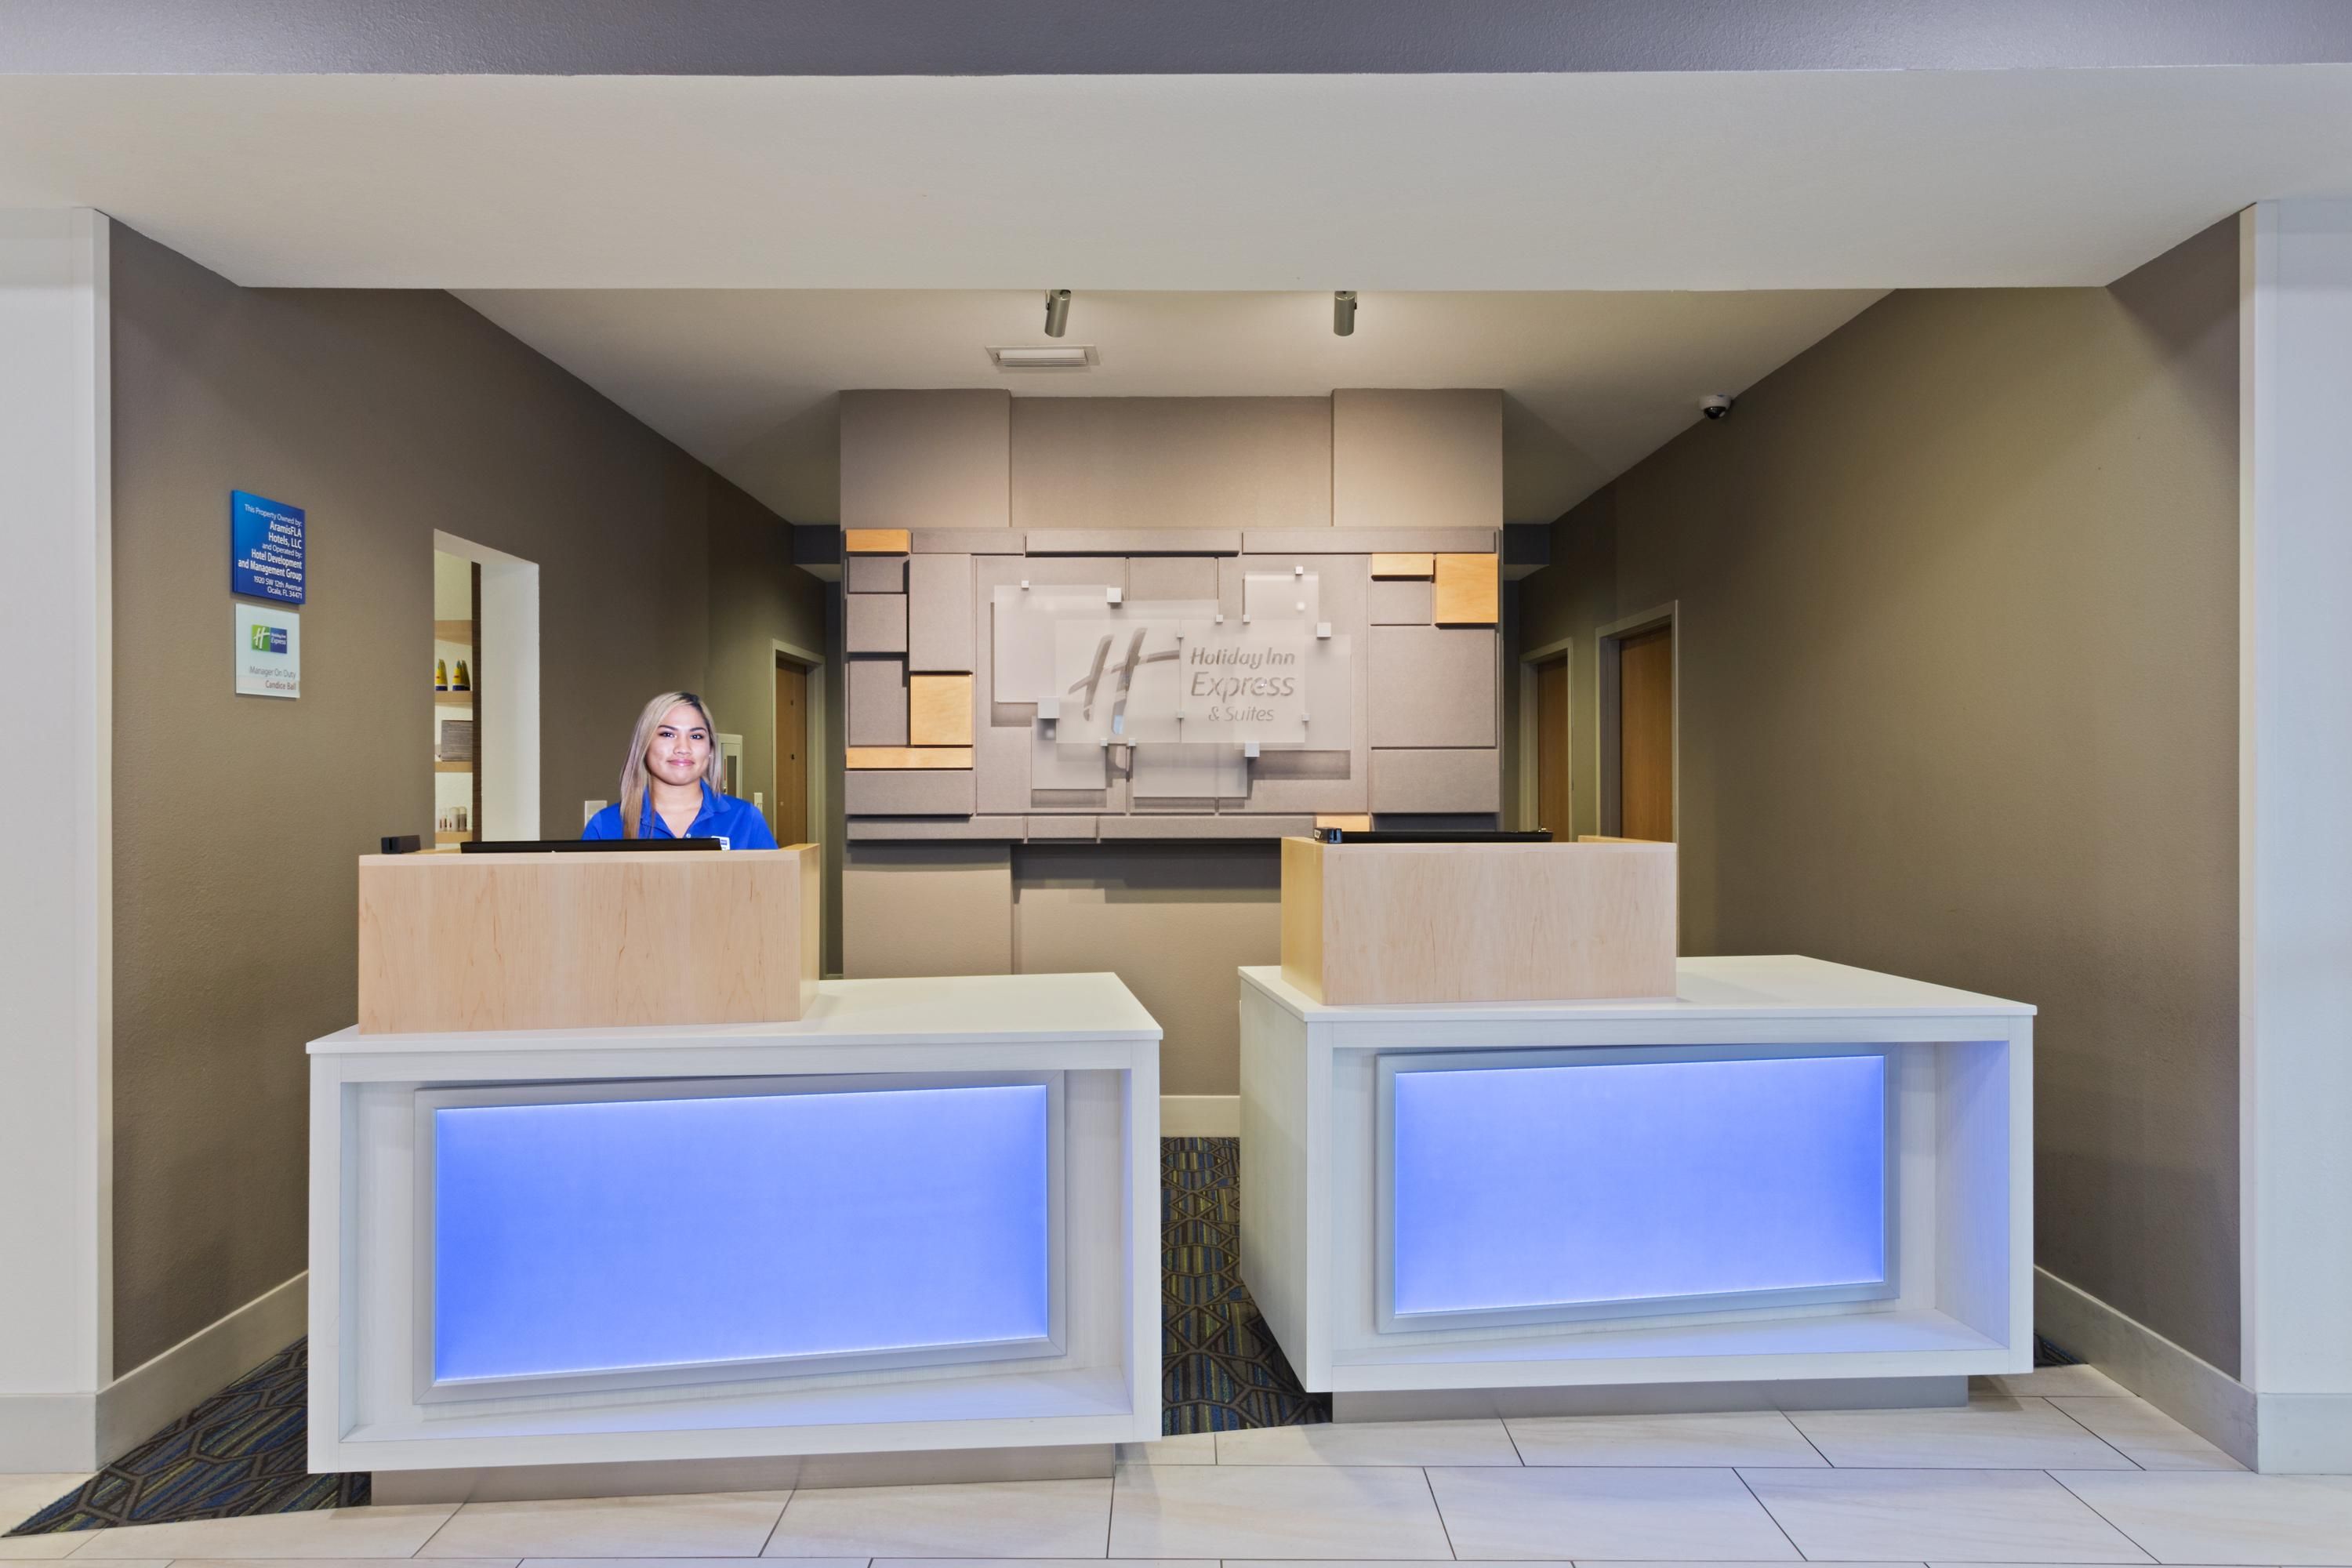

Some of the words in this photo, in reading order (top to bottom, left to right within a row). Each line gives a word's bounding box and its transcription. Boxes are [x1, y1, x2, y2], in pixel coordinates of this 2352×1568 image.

[245, 504, 255, 514] This
[256, 508, 277, 520] Property
[278, 514, 295, 524] Owned
[270, 521, 302, 538] AramisFLA
[268, 532, 290, 546] Hotels,
[291, 539, 302, 549] LLC
[262, 543, 272, 551] and
[272, 545, 295, 557] Operated
[251, 549, 267, 561] Hotel
[268, 554, 302, 570] Development
[238, 558, 249, 569] and
[250, 561, 285, 578] Management
[285, 568, 302, 583] Group
[266, 578, 274, 586] SW
[285, 582, 303, 593] Avenue
[267, 586, 282, 597] Ocala,
[283, 589, 289, 597] FL
[1190, 647, 1263, 670] Holiday
[1266, 647, 1295, 665] Inn
[249, 665, 274, 677] Manager
[1191, 671, 1296, 703] Express
[1208, 706, 1220, 721] &
[1225, 706, 1274, 721] Suites
